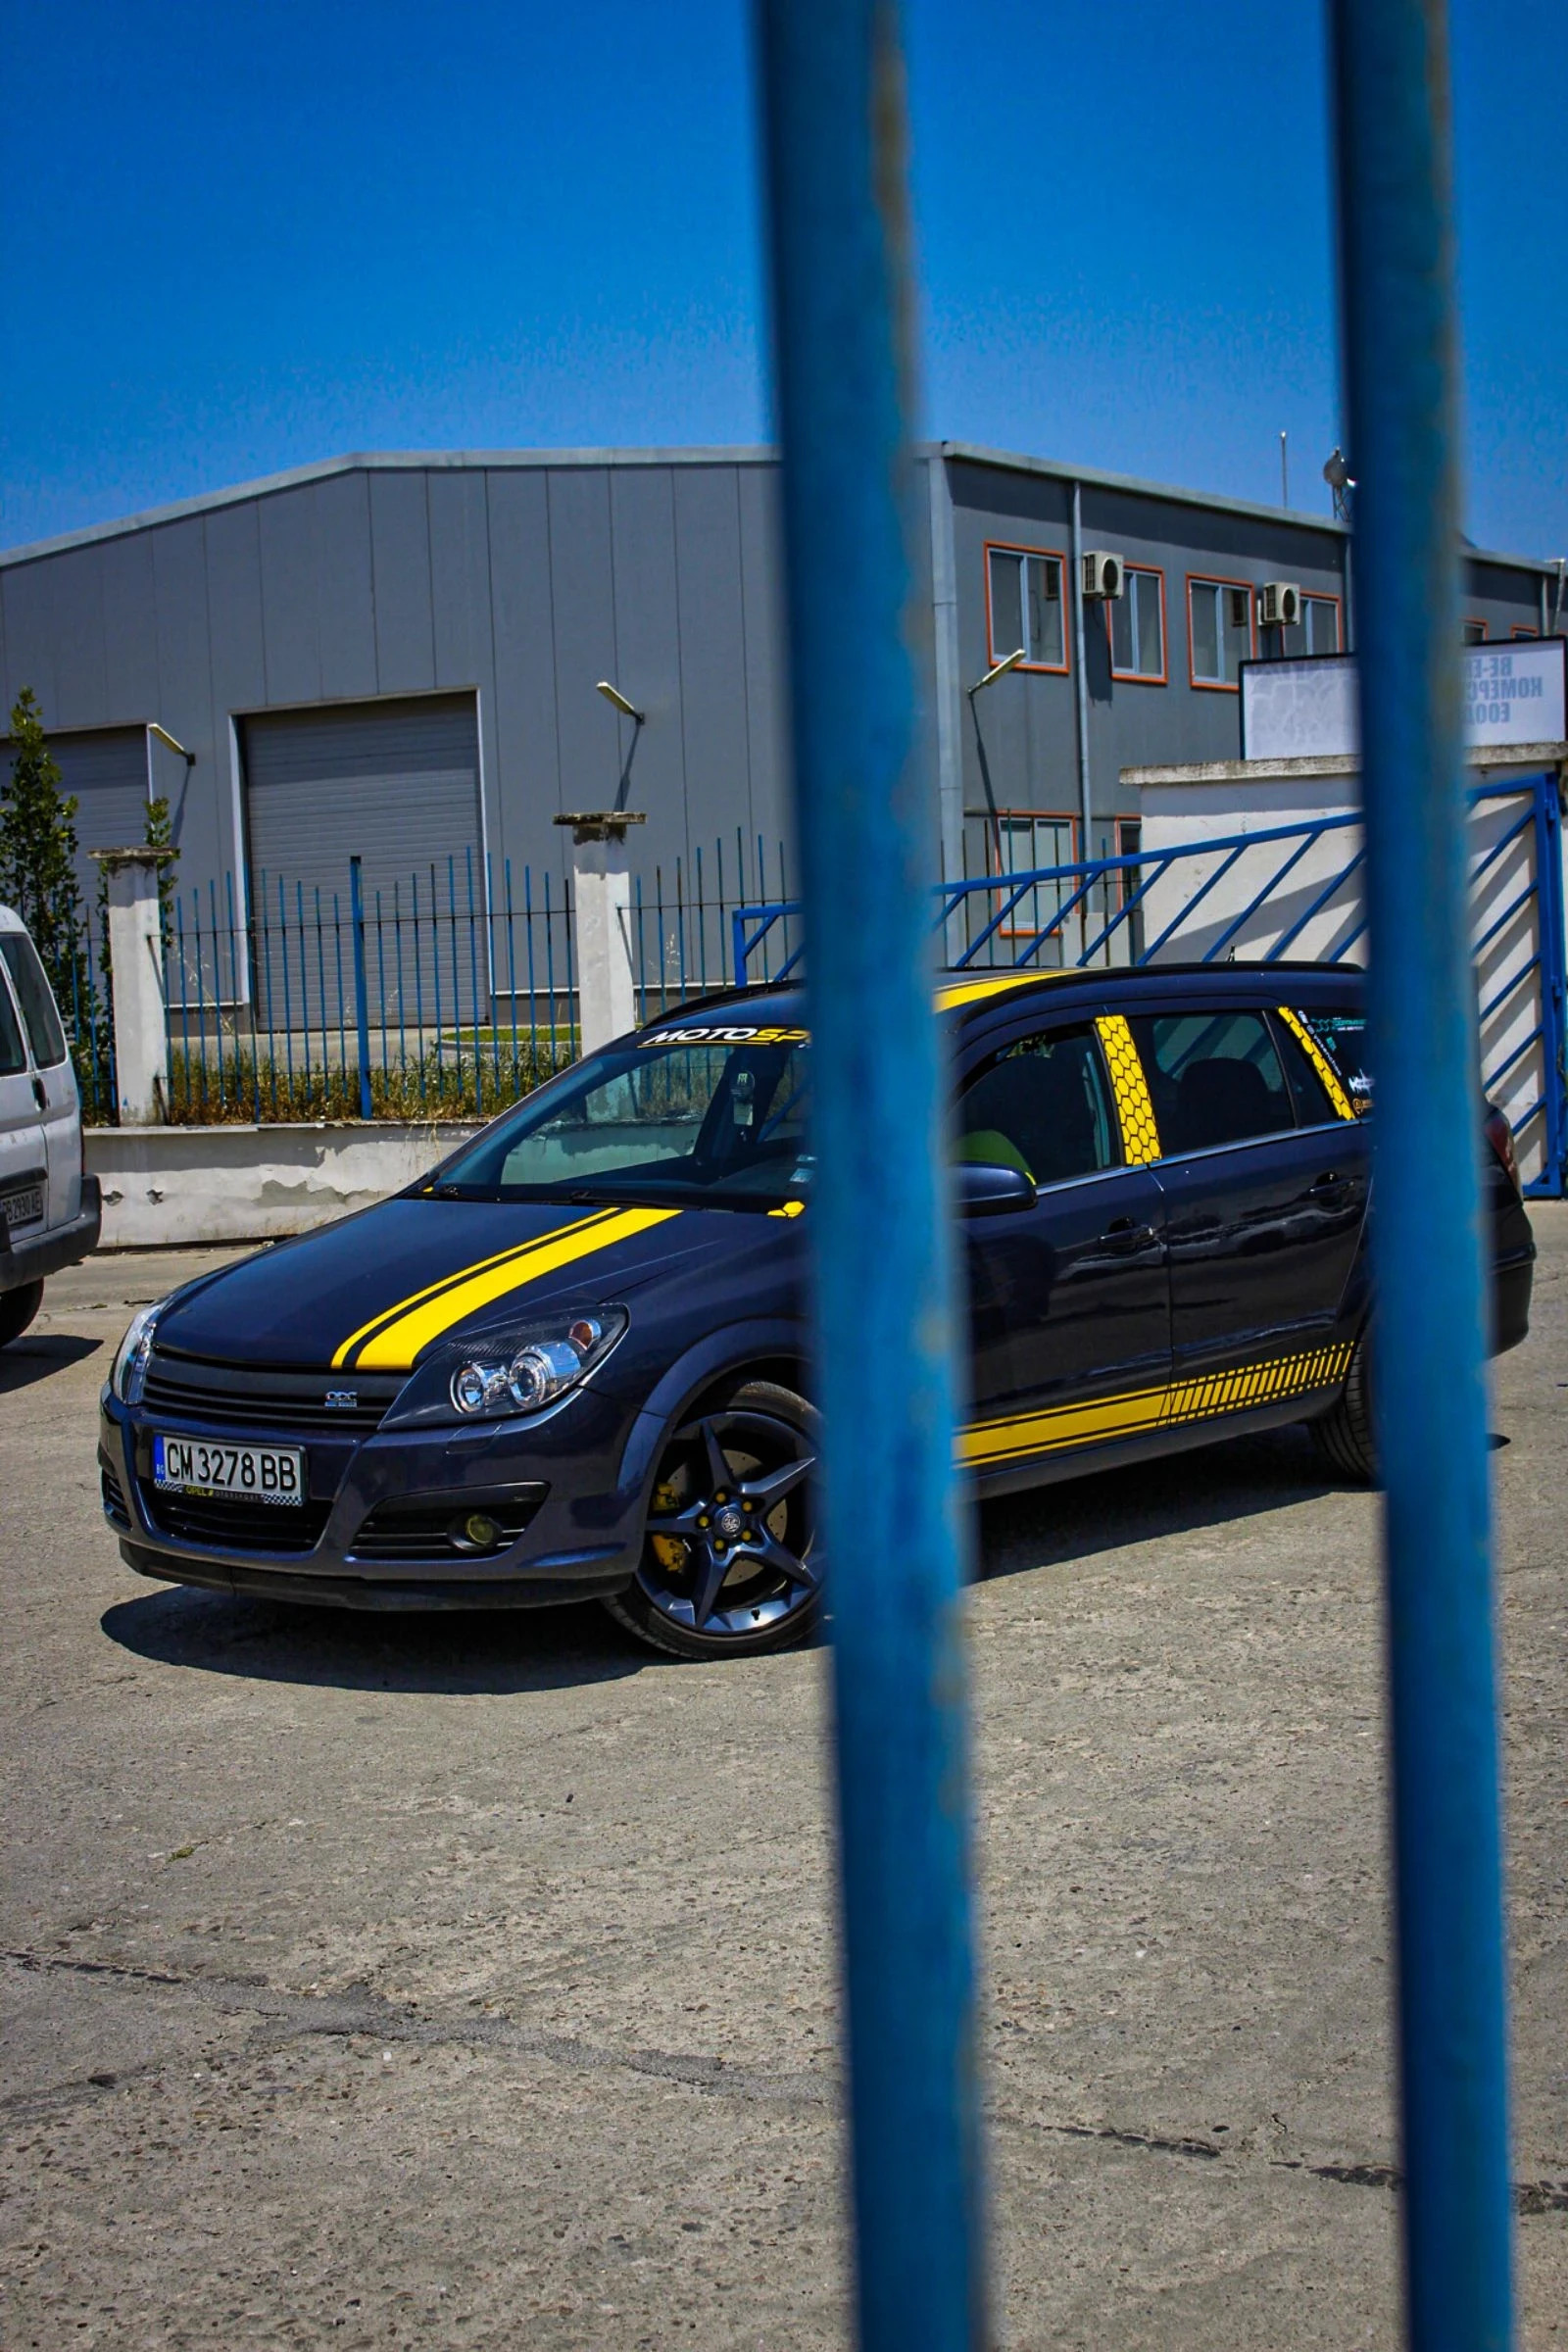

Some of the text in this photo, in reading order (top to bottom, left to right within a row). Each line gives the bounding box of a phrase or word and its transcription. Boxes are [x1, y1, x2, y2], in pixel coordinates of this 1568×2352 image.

[167, 1443, 296, 1491] CM 3278 BB
